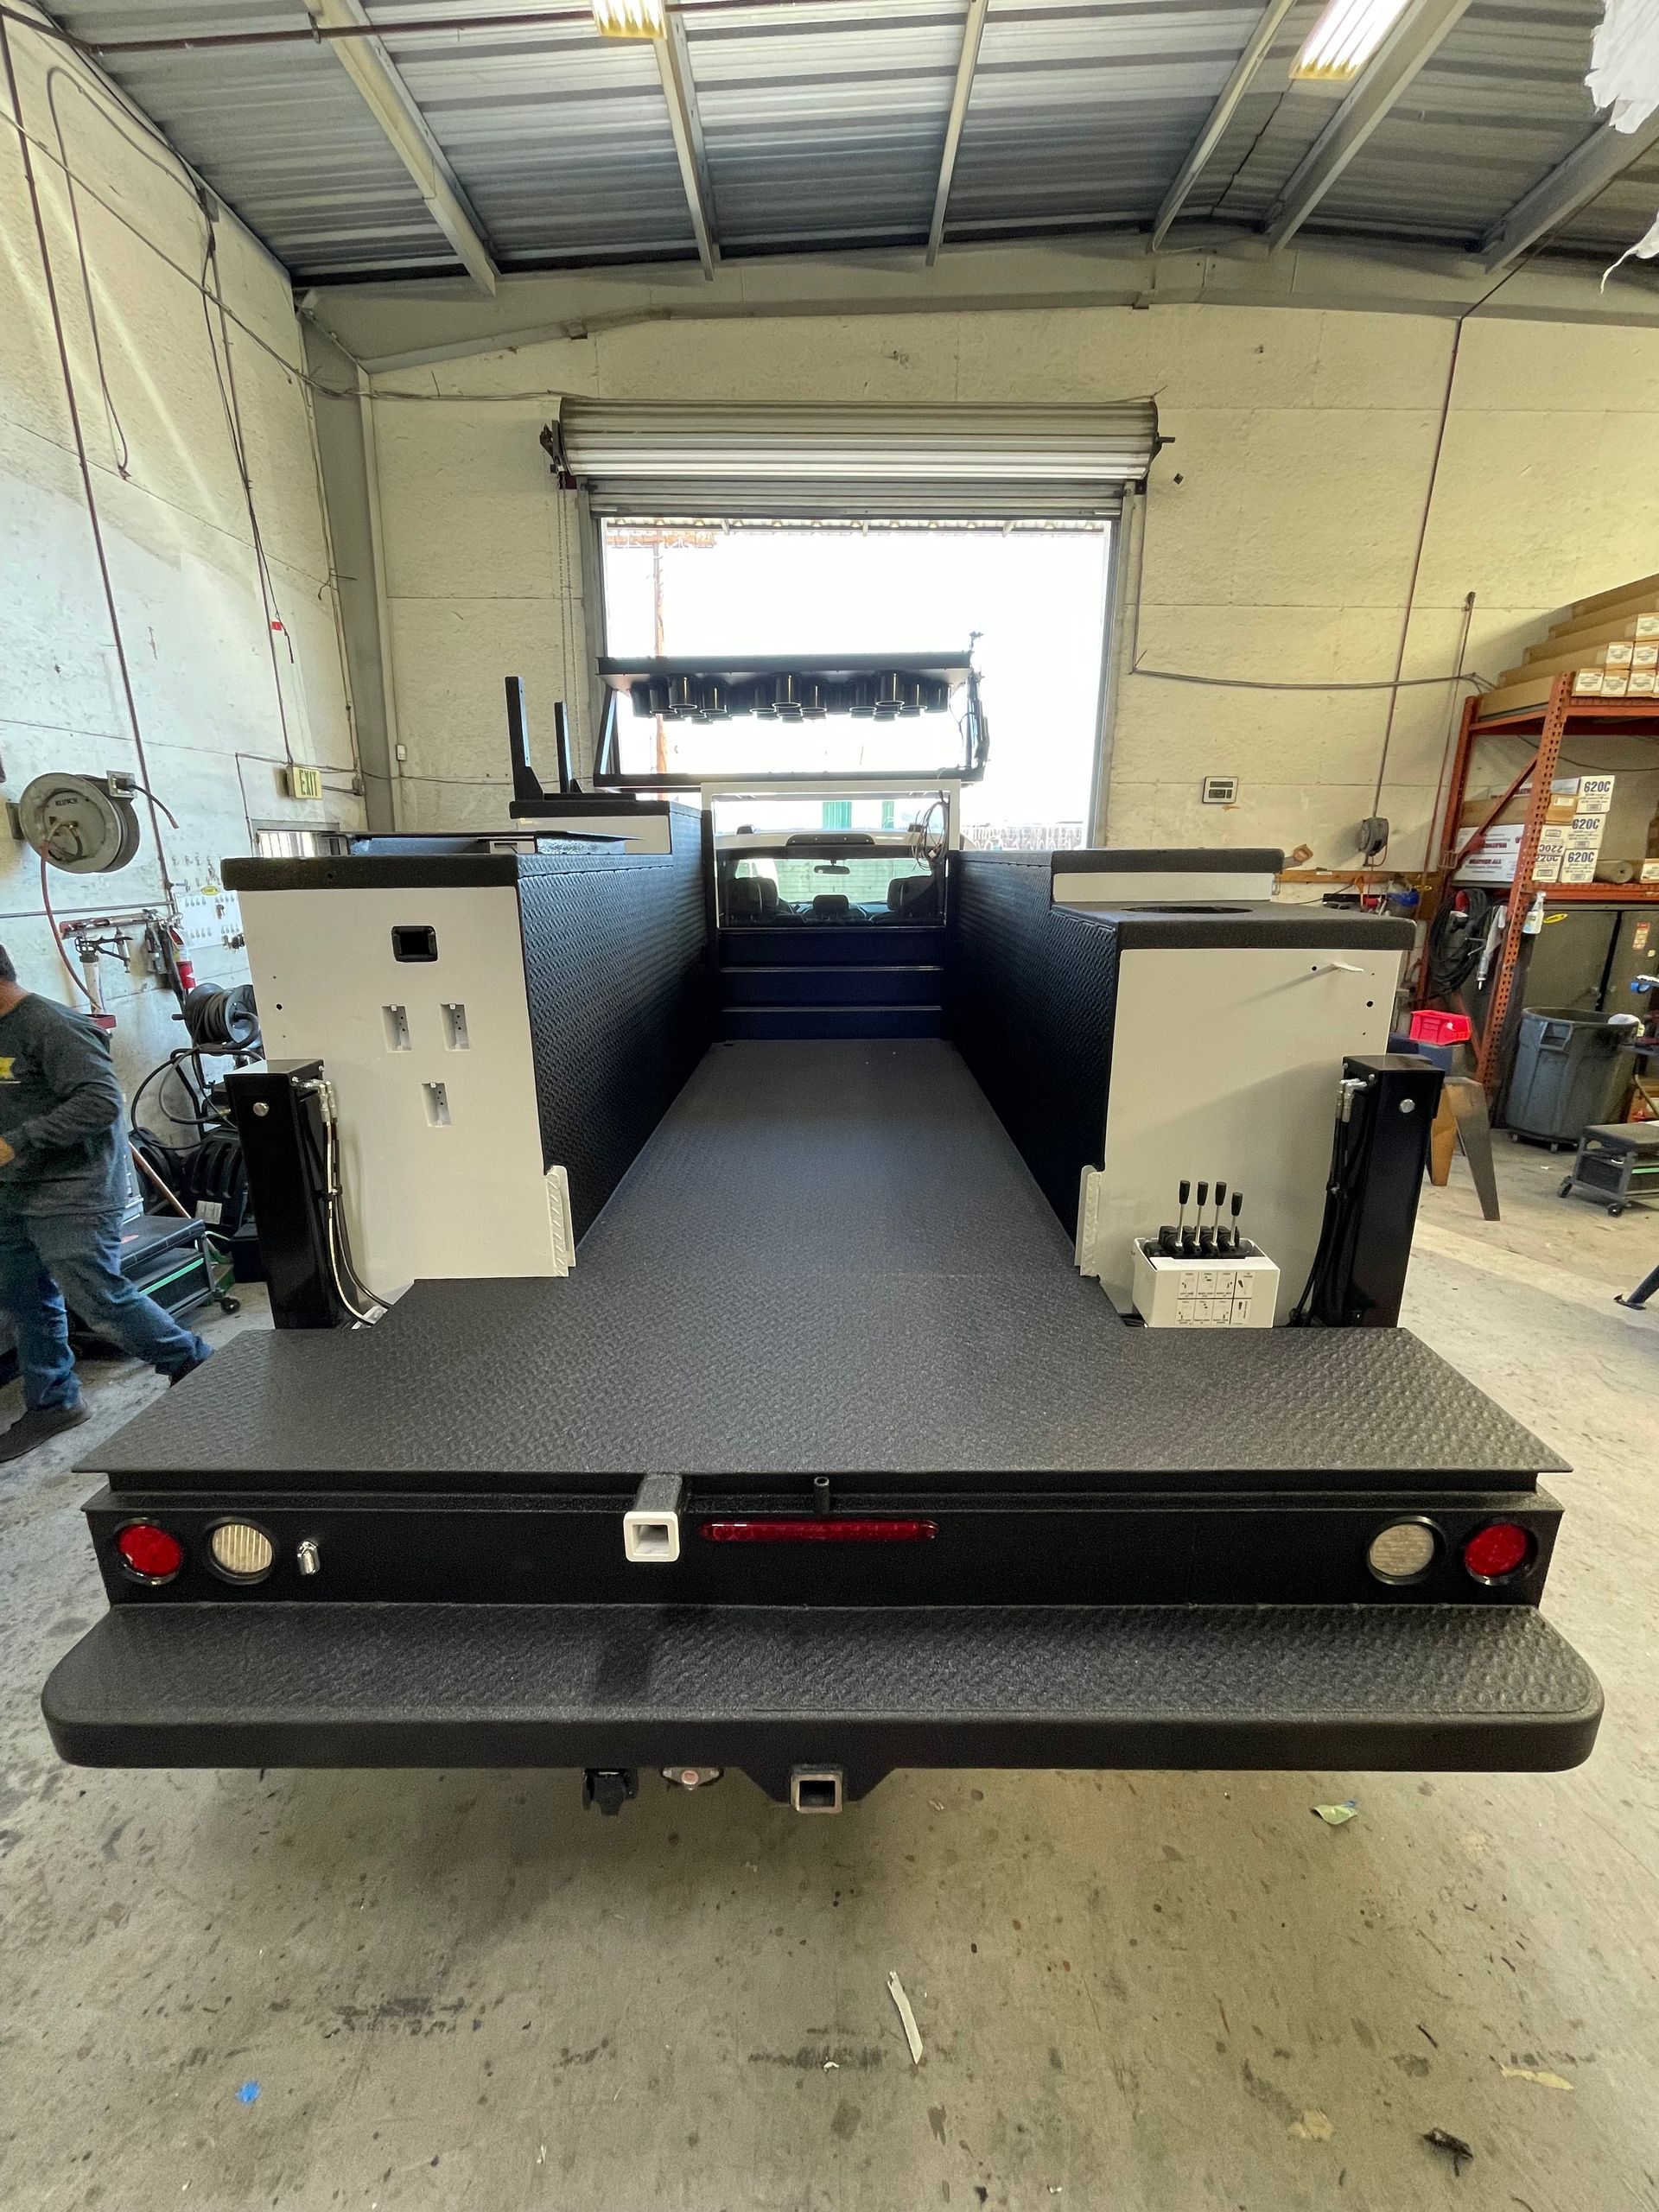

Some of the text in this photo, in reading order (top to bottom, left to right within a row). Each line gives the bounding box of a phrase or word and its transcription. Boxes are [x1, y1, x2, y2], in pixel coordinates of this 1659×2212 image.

[299, 769, 318, 796] EXIT
[1584, 781, 1611, 792] 620C
[1572, 818, 1600, 830] 620C
[1539, 844, 1564, 853] 220C
[1567, 852, 1595, 862] 620C
